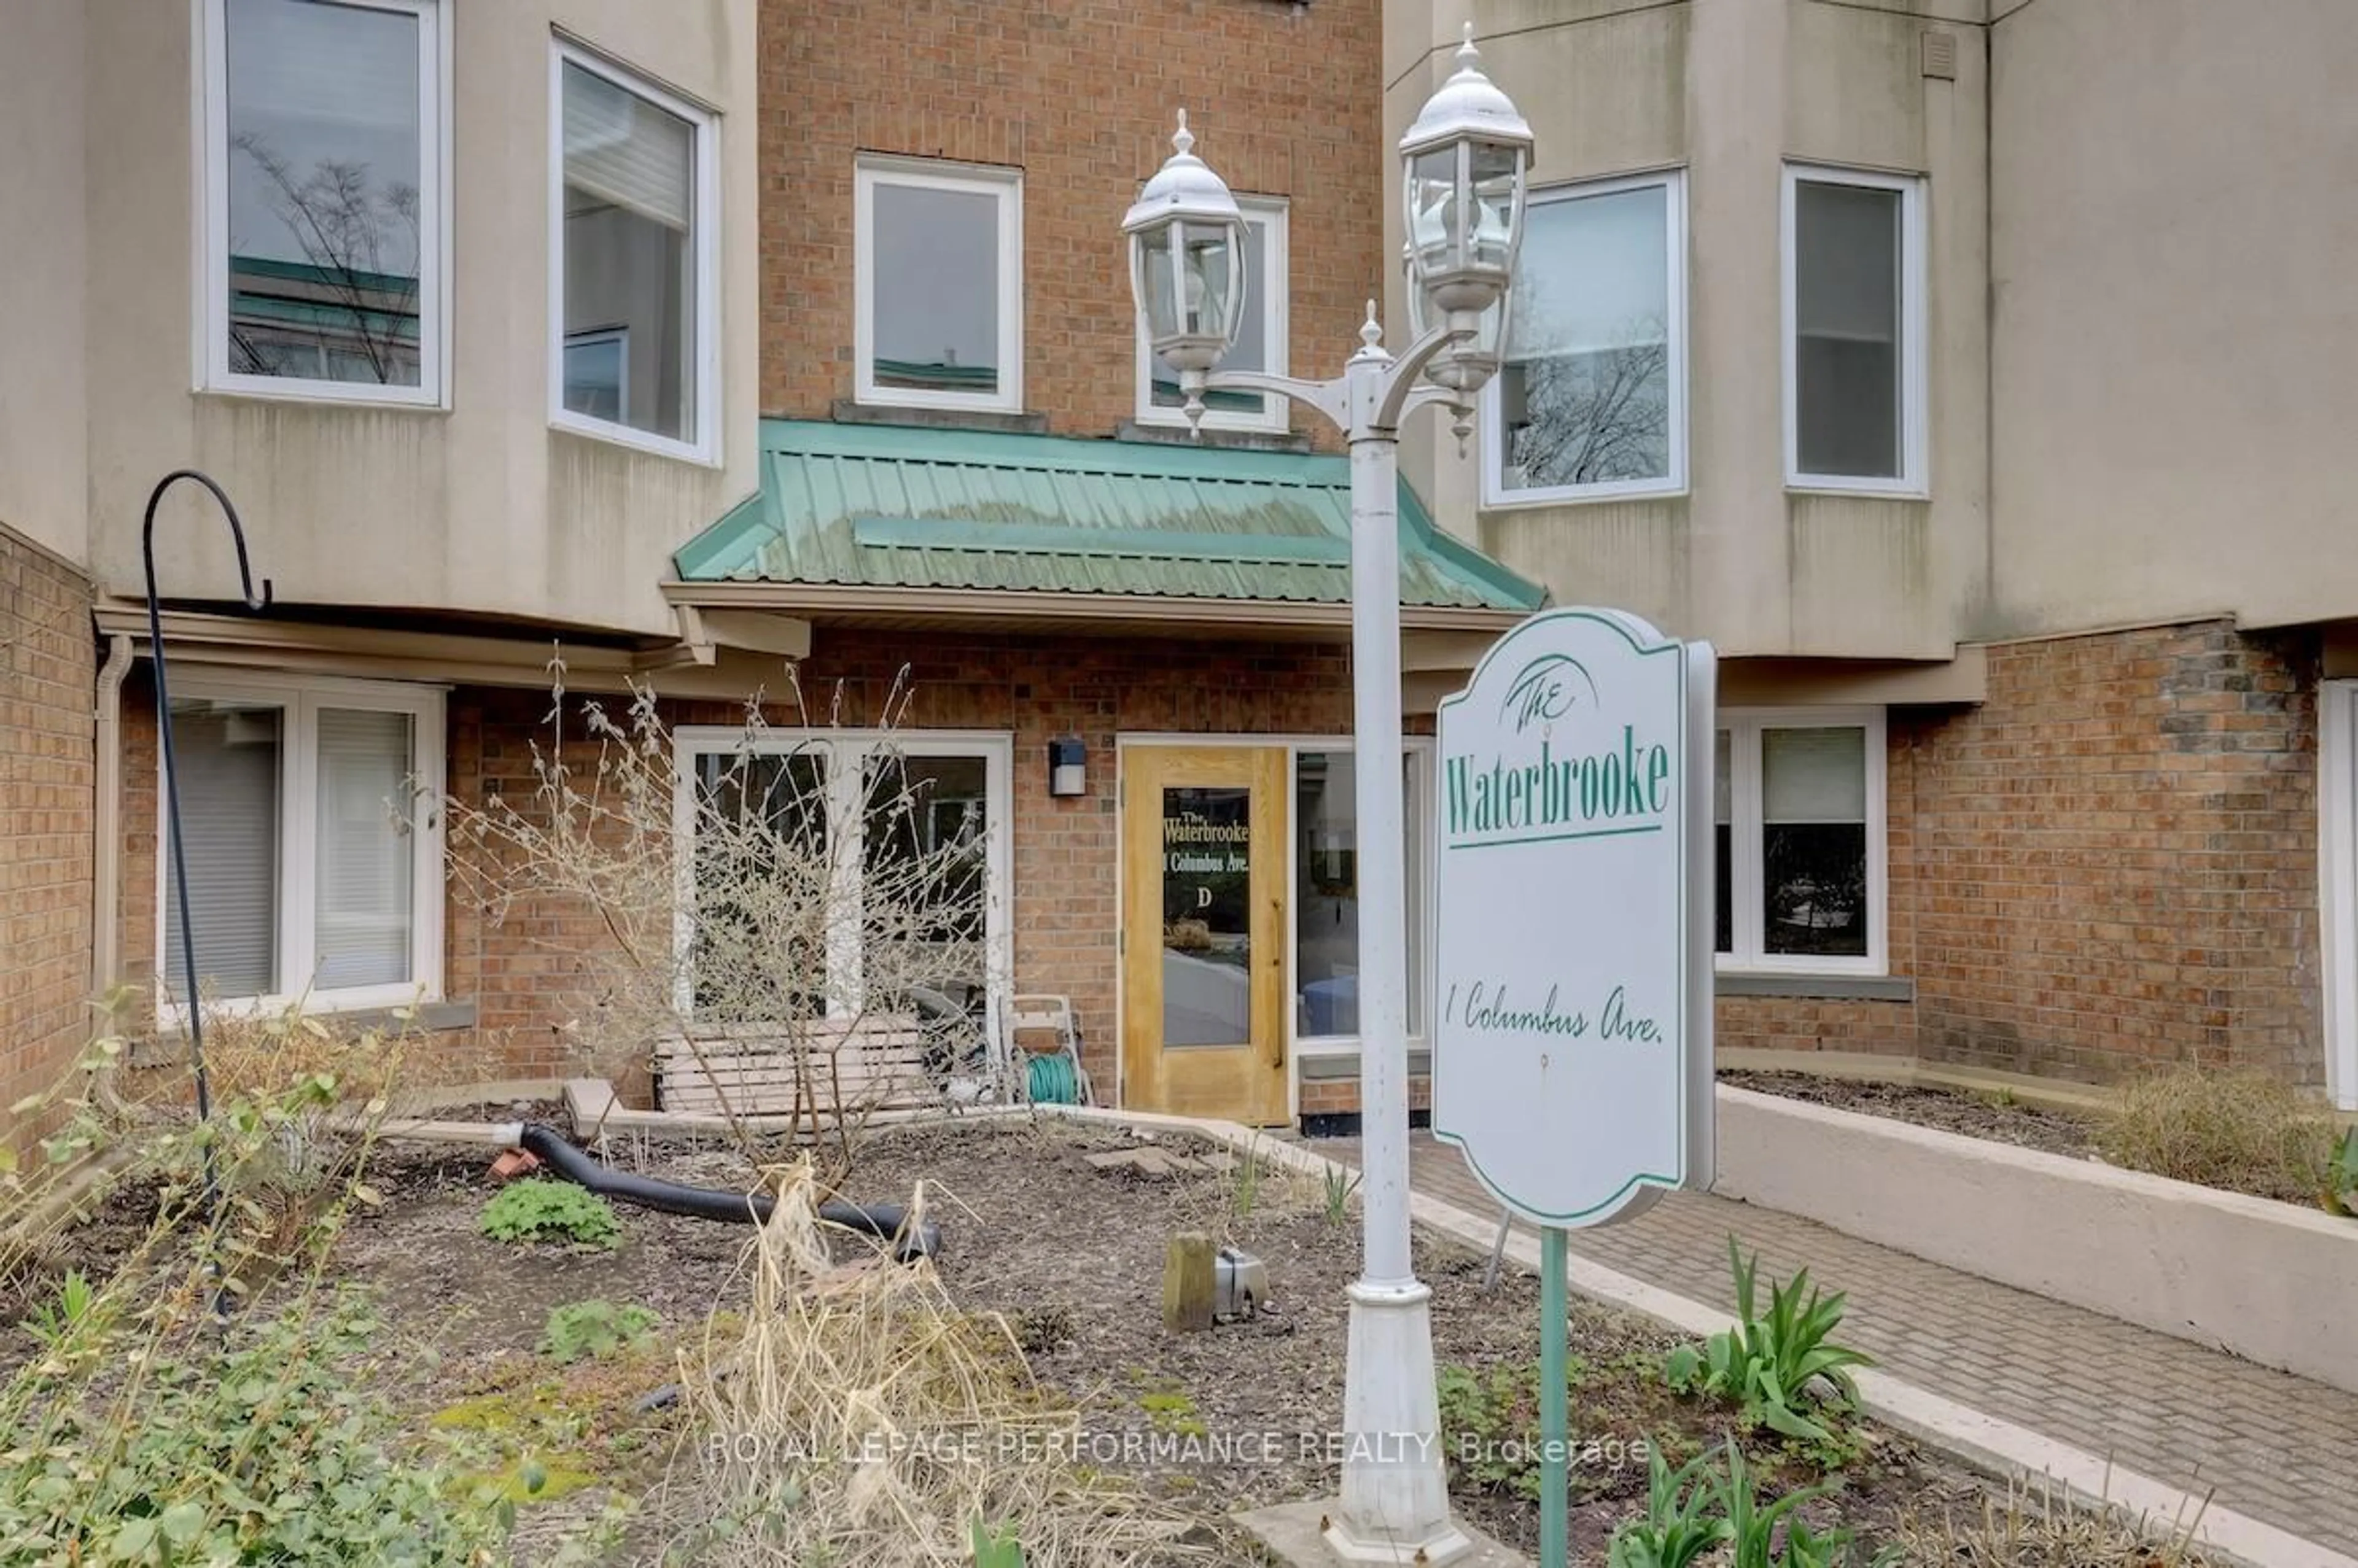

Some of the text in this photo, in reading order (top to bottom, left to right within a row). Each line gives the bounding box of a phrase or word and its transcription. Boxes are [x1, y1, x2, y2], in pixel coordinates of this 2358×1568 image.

[1447, 724, 1668, 834] Waterbrooke
[1181, 811, 1204, 822] The
[1164, 817, 1248, 843] Waterbrooke
[1170, 852, 1223, 872] Columbus
[1226, 852, 1249, 872] Ave.
[1197, 887, 1212, 907] D
[1446, 981, 1662, 1043] 1 Columbus Ave.
